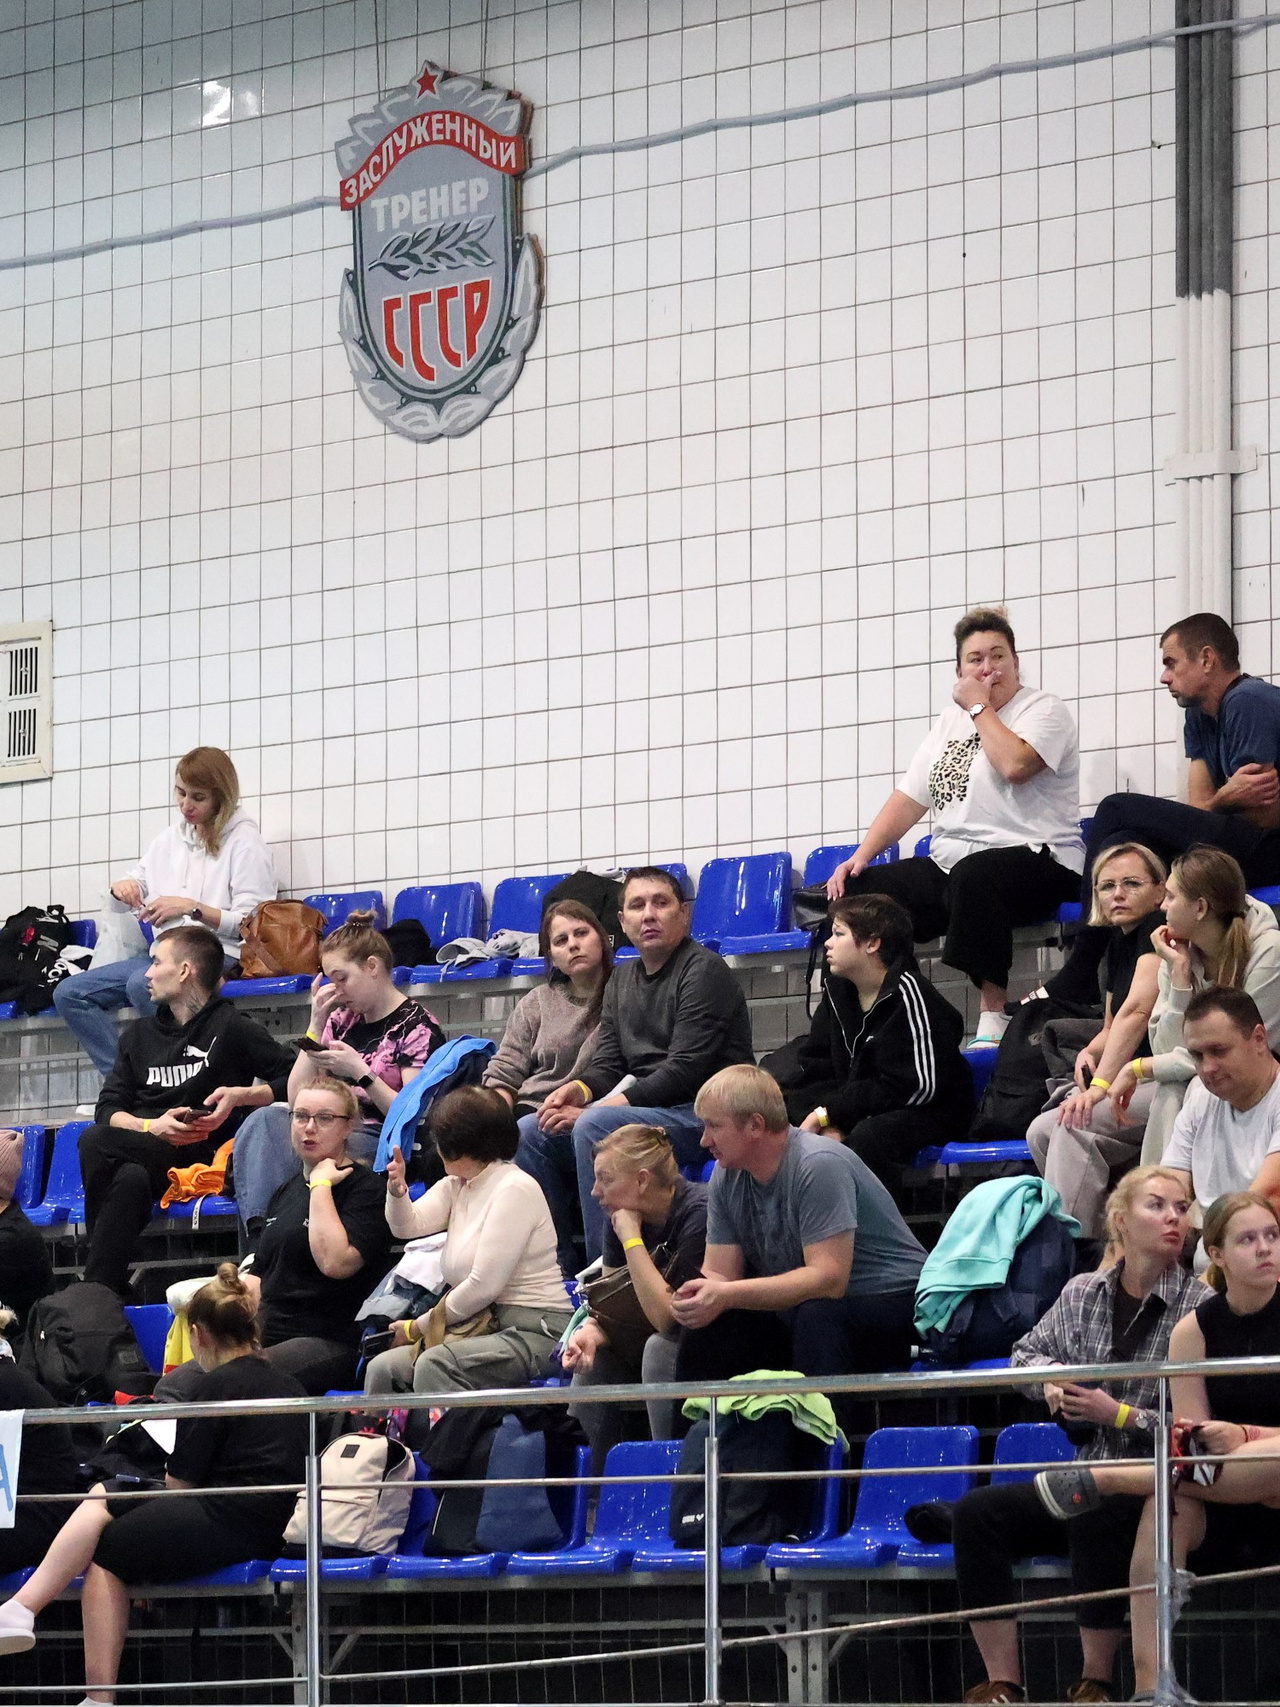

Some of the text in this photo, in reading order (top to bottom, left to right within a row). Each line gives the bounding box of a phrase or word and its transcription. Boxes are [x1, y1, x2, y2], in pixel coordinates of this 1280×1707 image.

[345, 113, 516, 204] ЗАСЛУЖЕННЫЙ
[371, 177, 489, 232] ТРЕНЕР
[382, 277, 492, 384] СССР
